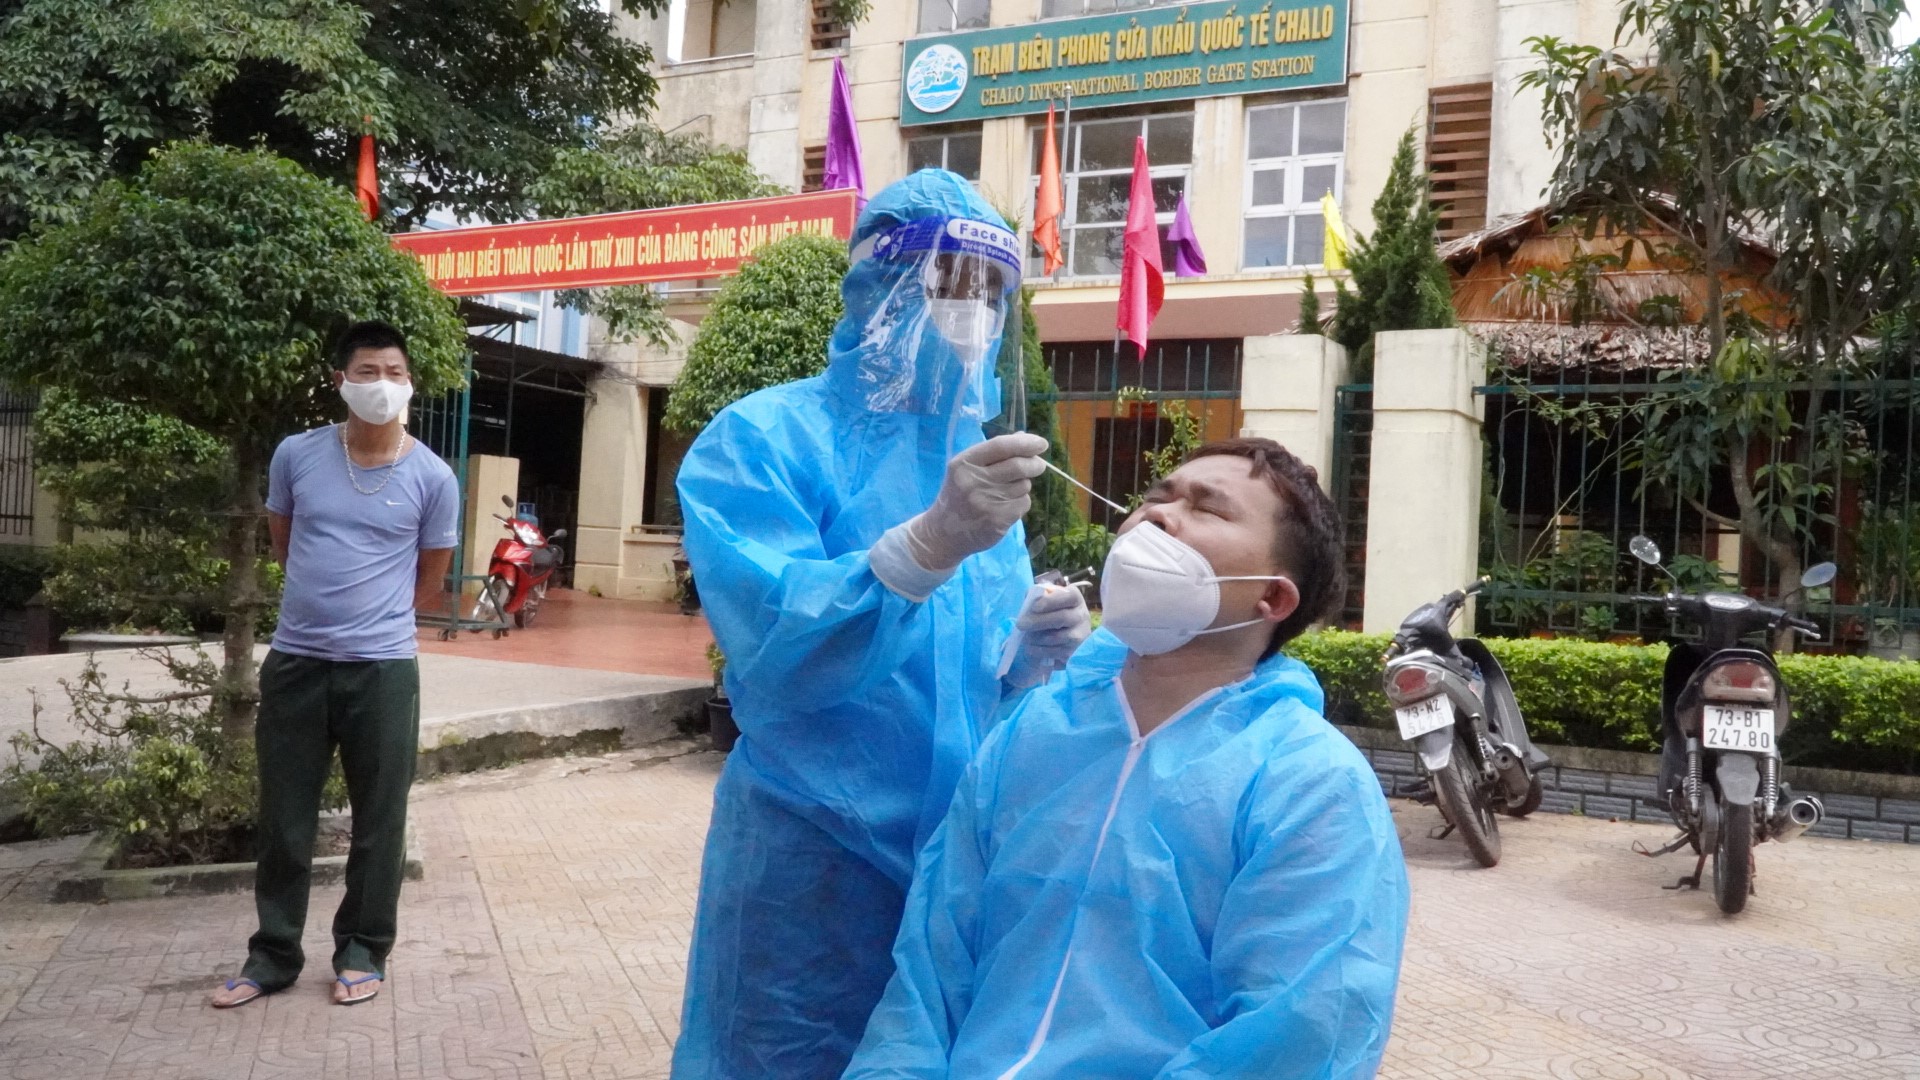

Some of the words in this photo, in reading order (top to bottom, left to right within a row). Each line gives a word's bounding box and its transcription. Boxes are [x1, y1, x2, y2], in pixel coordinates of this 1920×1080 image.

[972, 42, 1015, 81] TRẠM
[1017, 32, 1053, 71] BIÊN
[1115, 19, 1147, 61] CỬA
[1151, 7, 1196, 57] KHẨU
[1200, 4, 1245, 54] QUỐC
[1250, 1, 1272, 46] TẾ
[1274, 5, 1334, 43] CHALO
[980, 85, 1025, 106] CHALO
[1028, 73, 1139, 102] INTERNATIONAL
[1143, 67, 1202, 91] BORDER
[1206, 61, 1246, 84] GATE
[1251, 55, 1316, 79] STATION
[959, 223, 998, 242] Face
[438, 247, 455, 286] HỘI
[457, 251, 475, 285] ĐẠI
[476, 238, 501, 277] BIỂU
[503, 241, 531, 276] TOÀN
[533, 234, 563, 277] QUỐC
[565, 232, 588, 271] LẦN
[590, 232, 614, 269] THỨ
[614, 237, 635, 267] XIII
[637, 225, 661, 265] CỦA
[664, 222, 699, 263] ĐẢNG
[701, 222, 737, 266] CỘNG
[1403, 699, 1441, 720] 73-N2
[1715, 709, 1762, 729] 73-B1
[1708, 728, 1770, 749] 247.80
